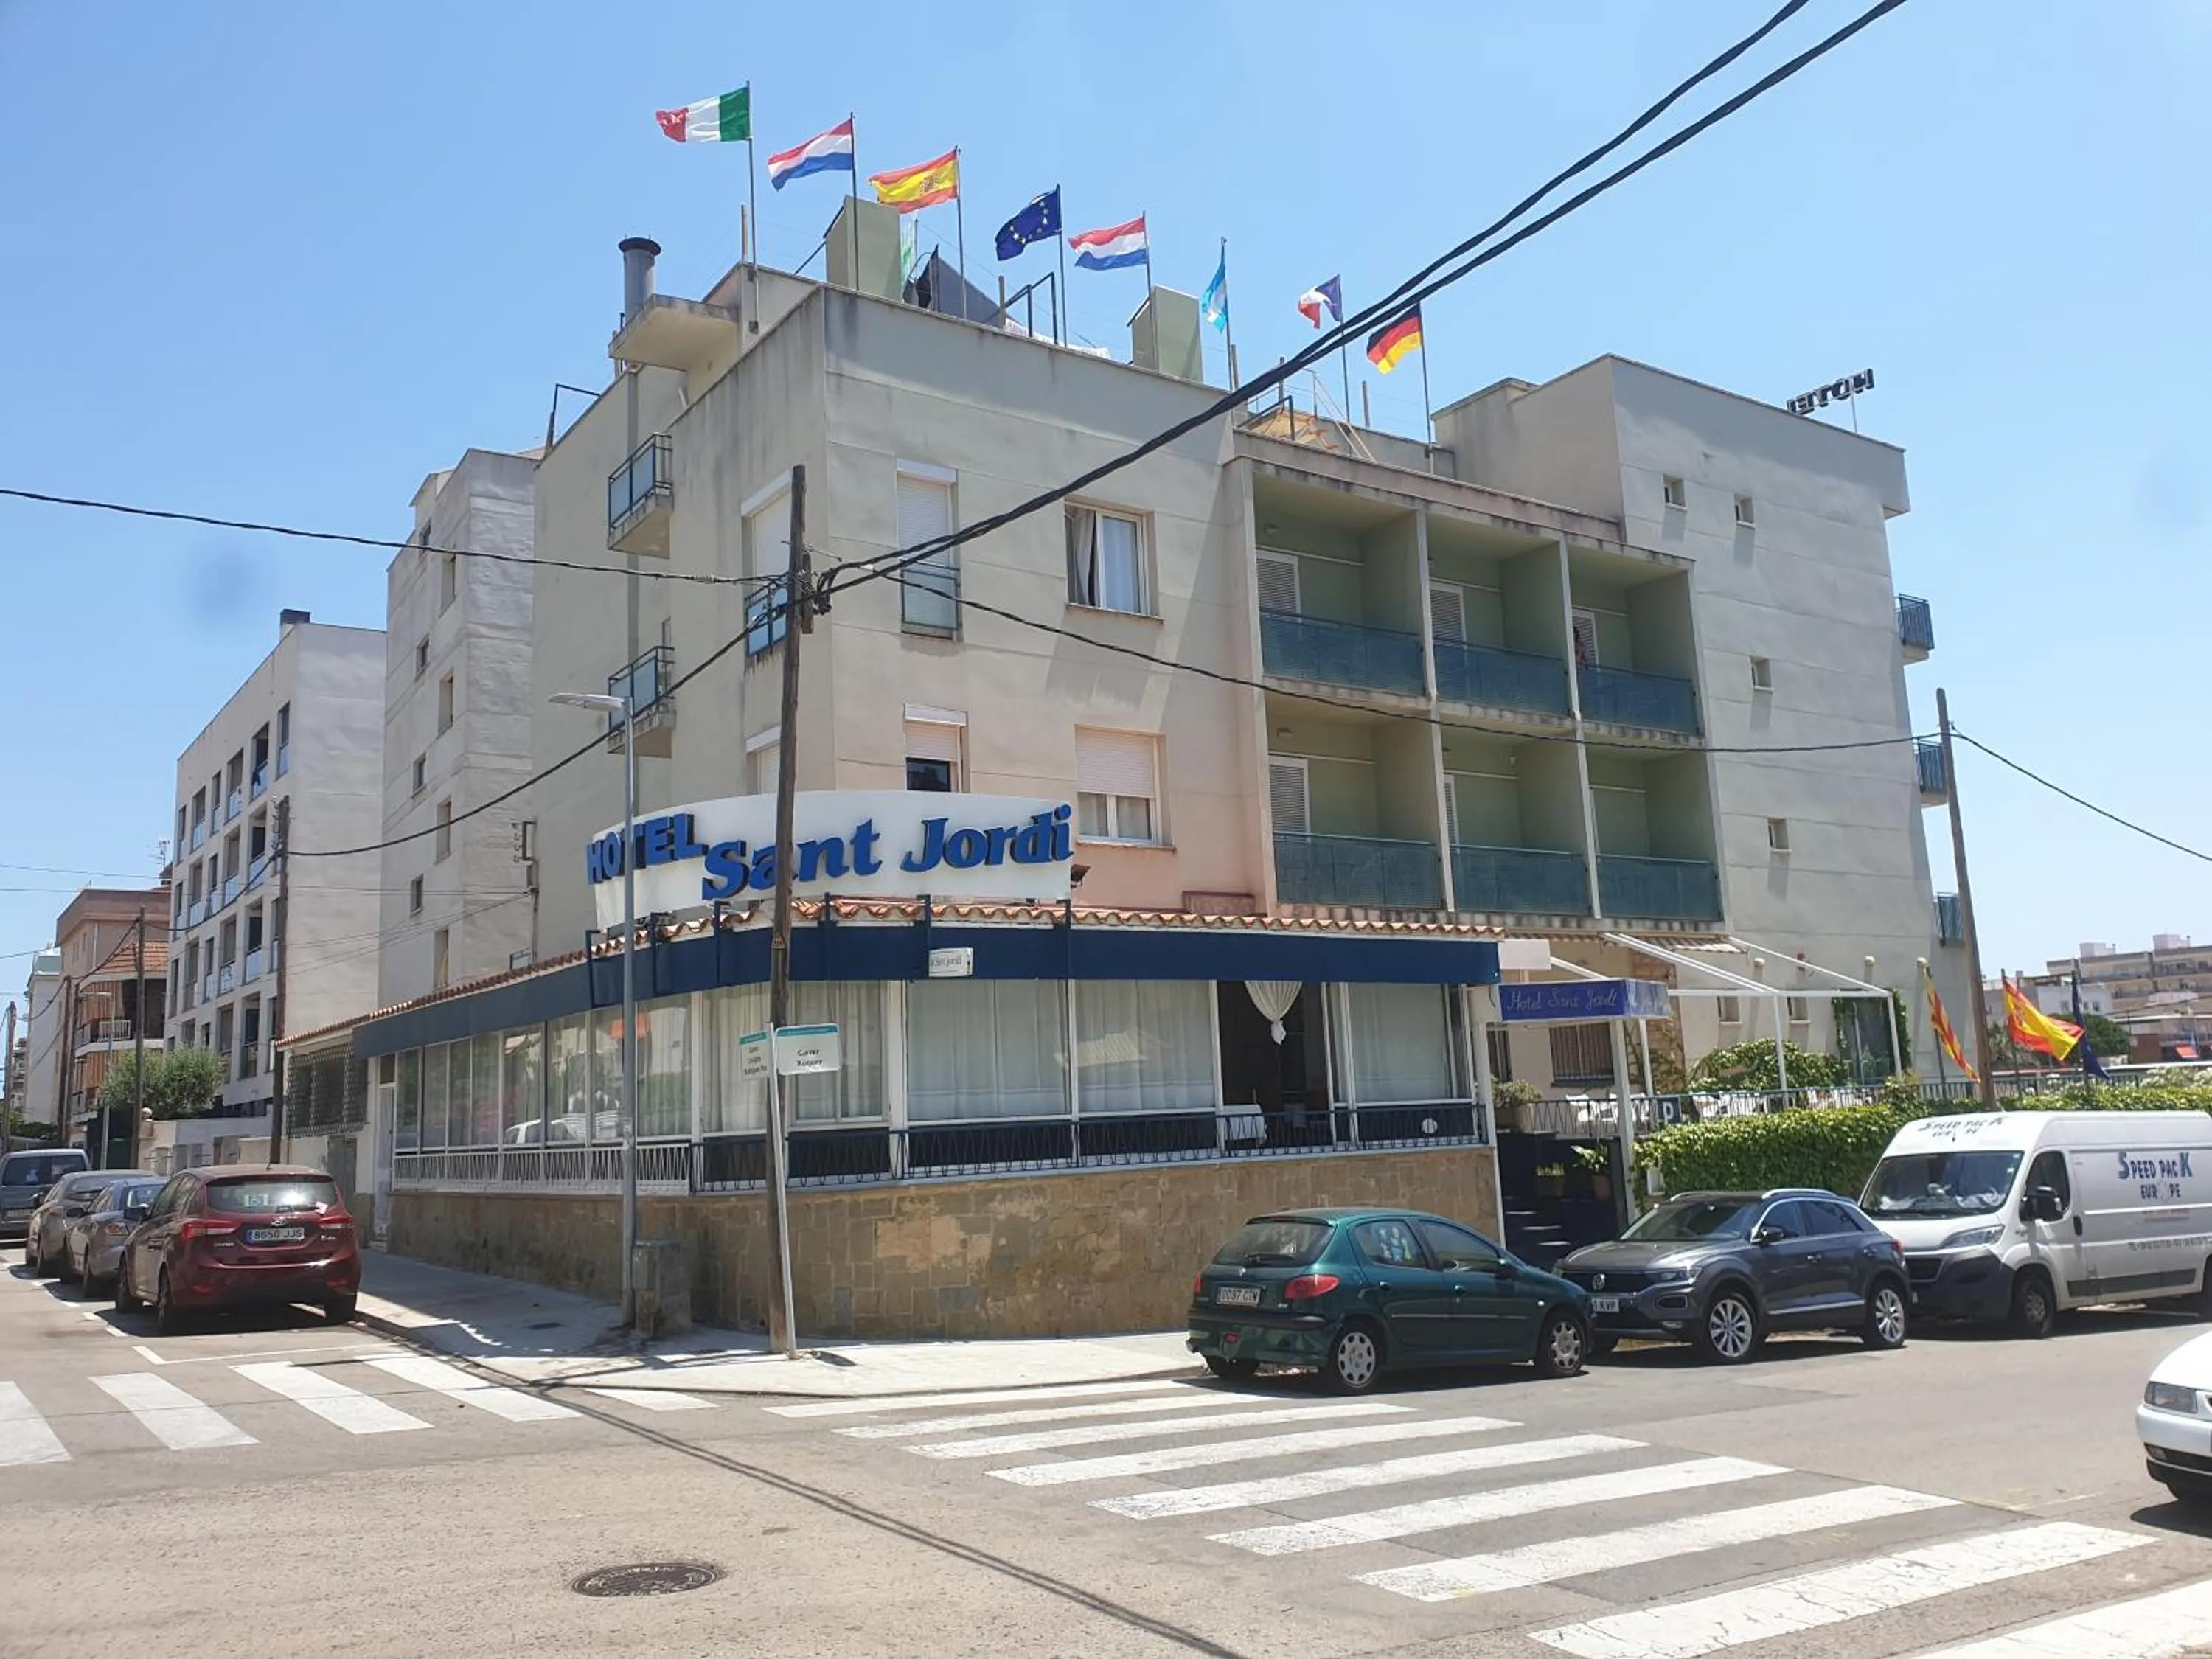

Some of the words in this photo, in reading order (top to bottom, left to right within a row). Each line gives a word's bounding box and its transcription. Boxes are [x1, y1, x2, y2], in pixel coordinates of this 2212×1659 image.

[587, 812, 709, 886] HOTEL
[702, 818, 883, 900] Sant
[900, 804, 1074, 873] Jordi
[1916, 1121, 1961, 1132] SPEED
[2118, 1150, 2157, 1180] SPEED
